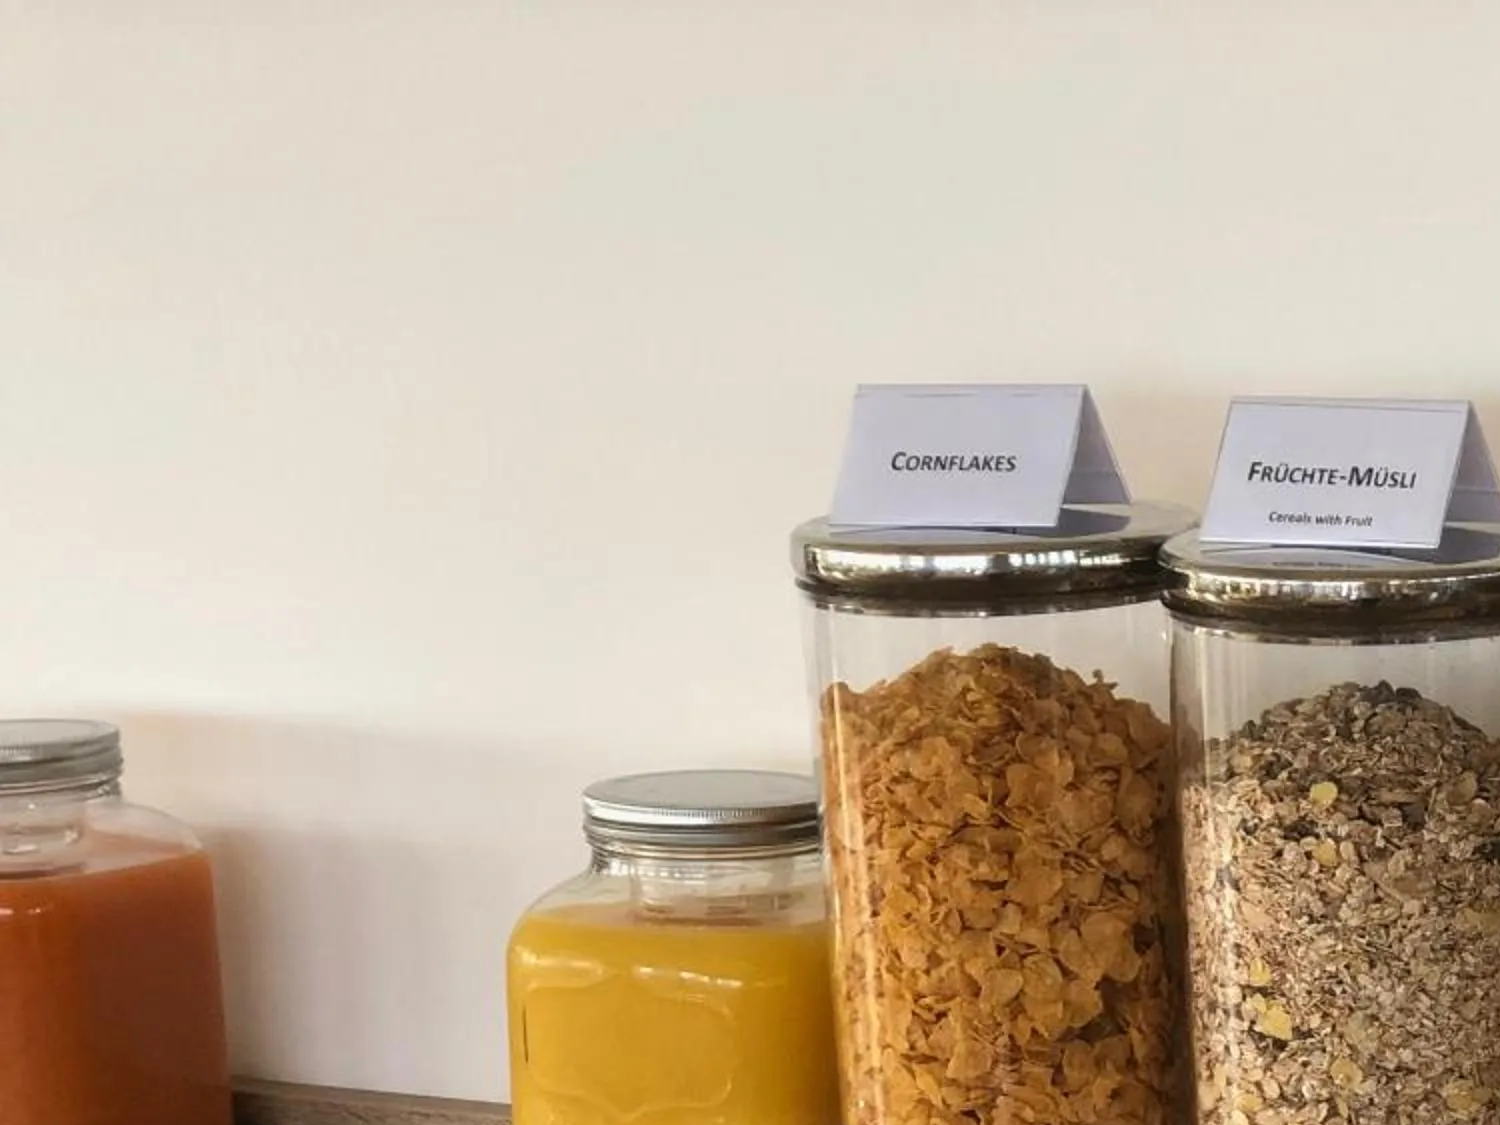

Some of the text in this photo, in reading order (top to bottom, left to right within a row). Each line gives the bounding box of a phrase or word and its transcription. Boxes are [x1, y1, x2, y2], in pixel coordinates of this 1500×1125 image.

[890, 451, 1017, 473] CORNFLAKES
[1247, 460, 1417, 489] FRÜCHTE-MÜSLI
[1268, 511, 1373, 527] Cereals with Fruit
